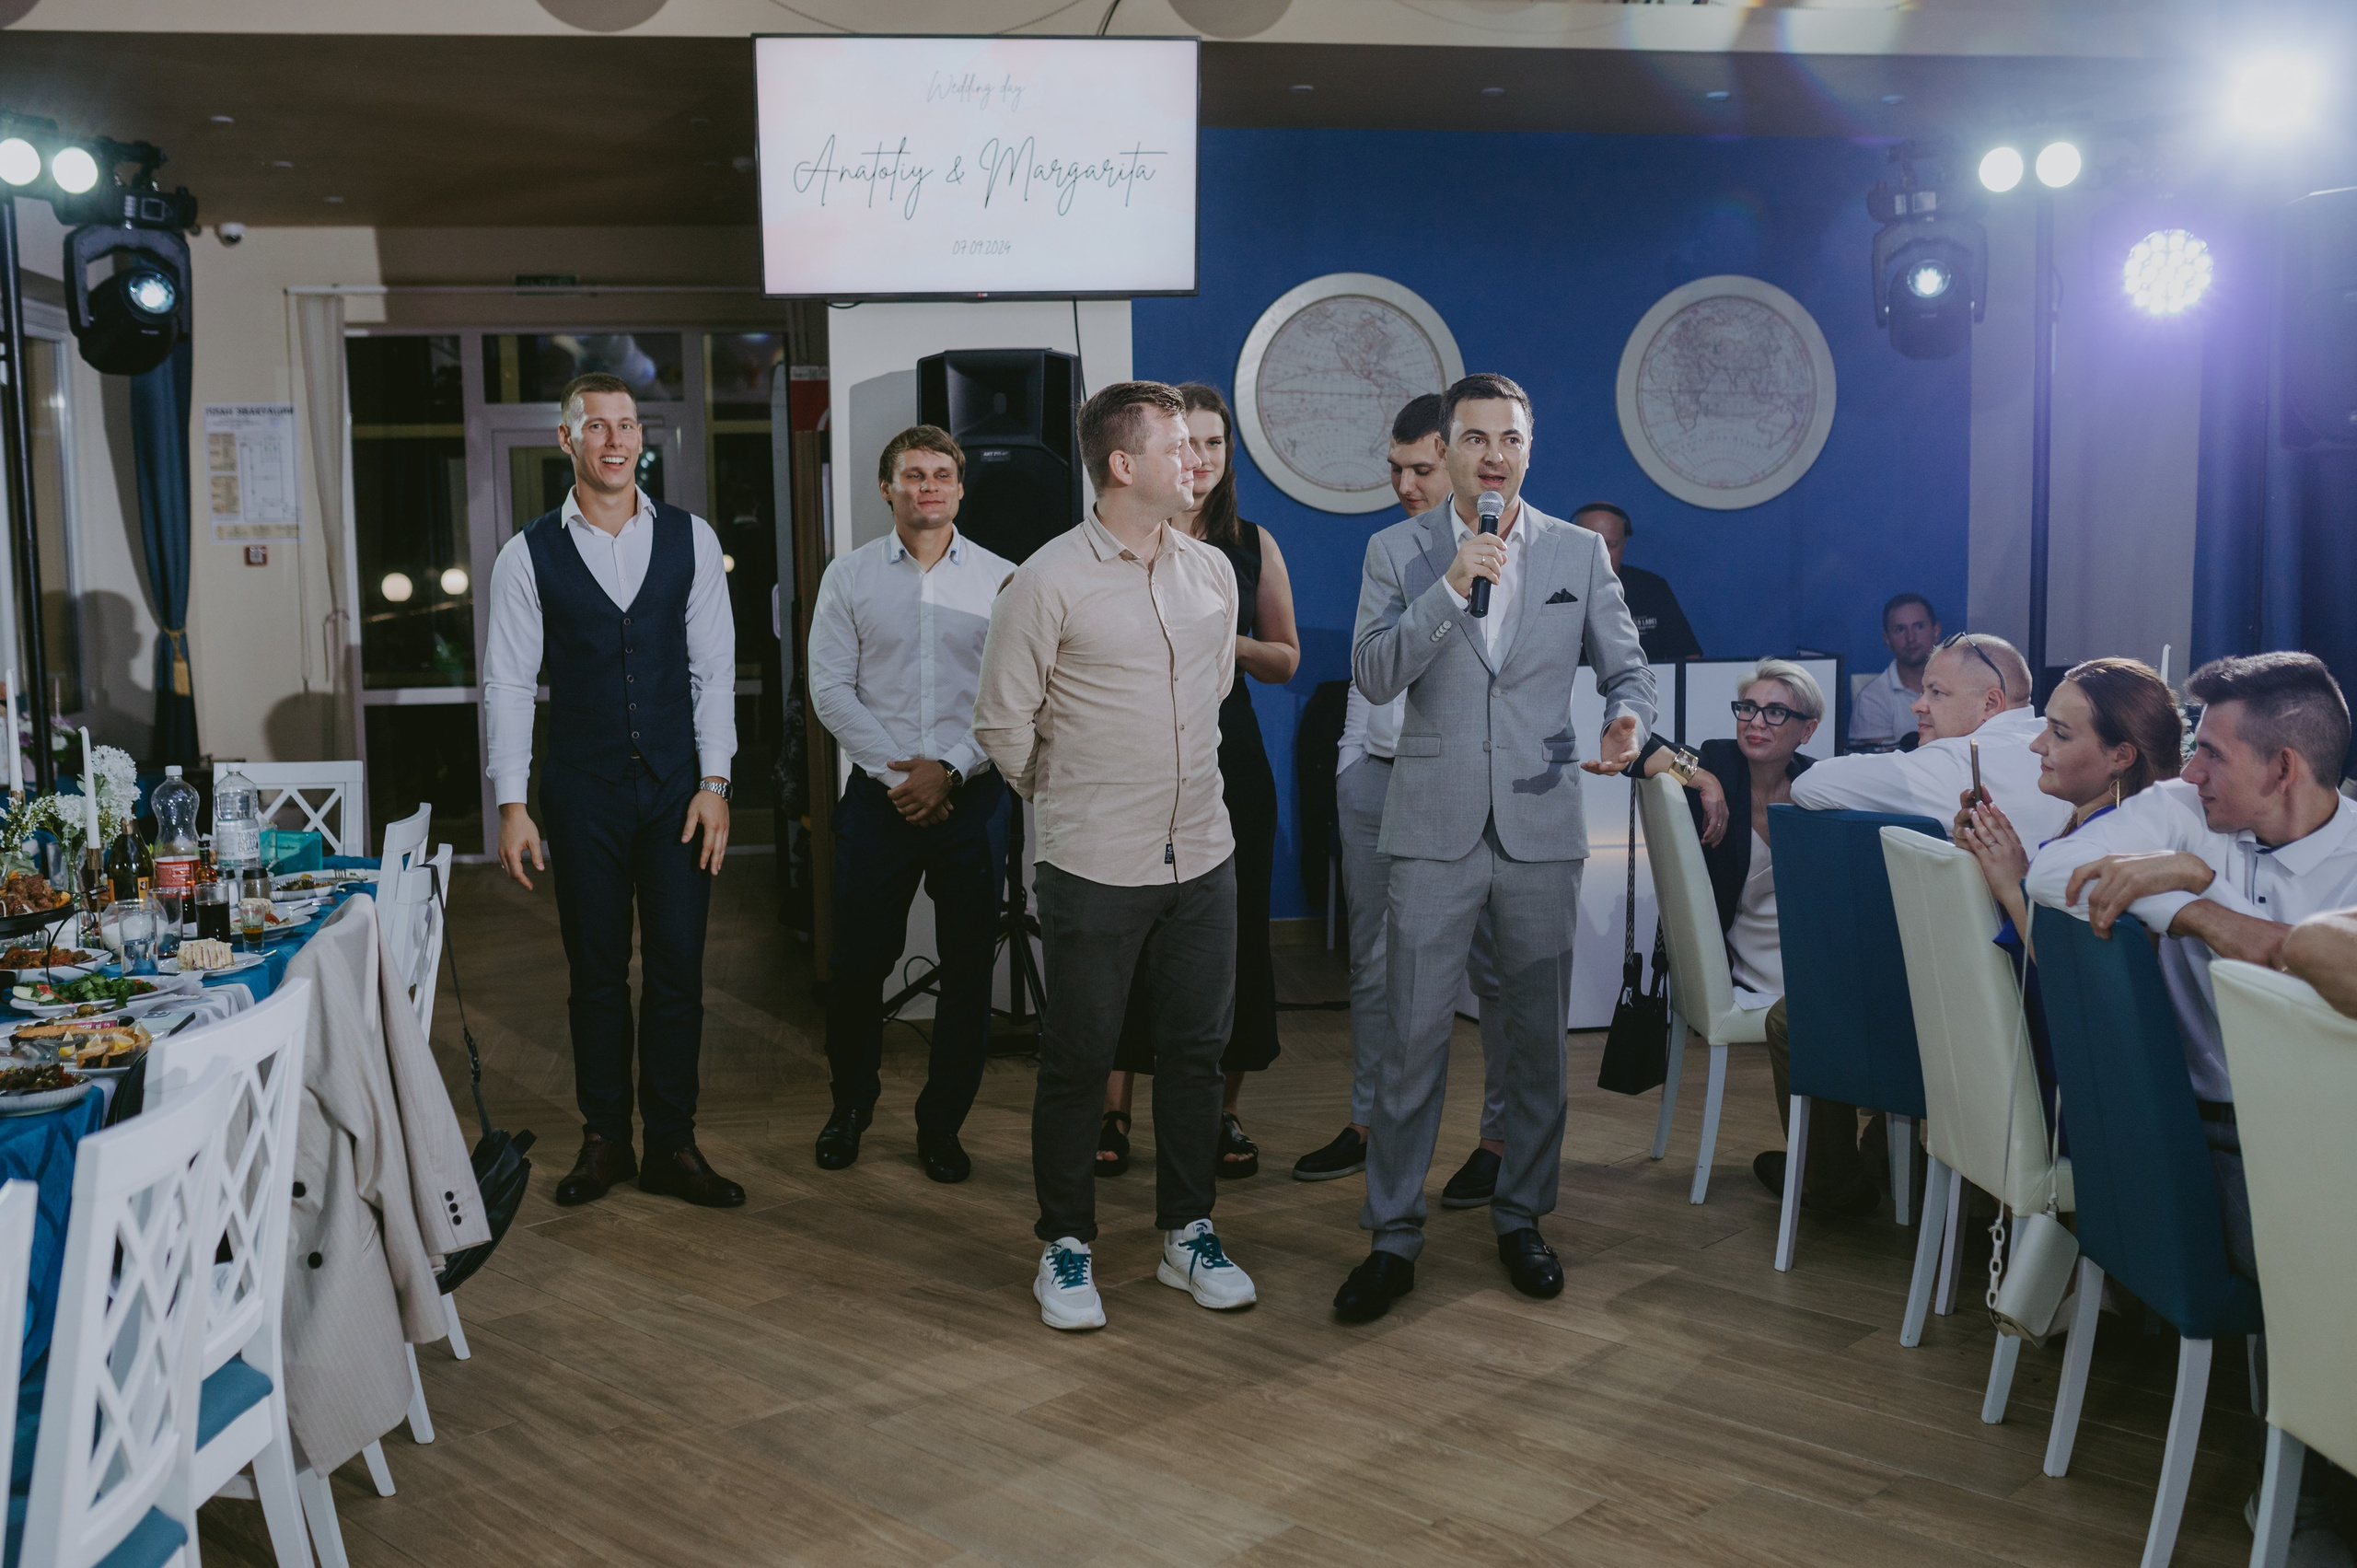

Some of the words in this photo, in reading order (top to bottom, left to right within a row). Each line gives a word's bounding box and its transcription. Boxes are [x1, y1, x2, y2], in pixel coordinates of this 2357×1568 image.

[926, 71, 995, 111] Wedding
[1000, 73, 1027, 112] day
[946, 156, 965, 185] &
[979, 135, 1168, 216] Margarita
